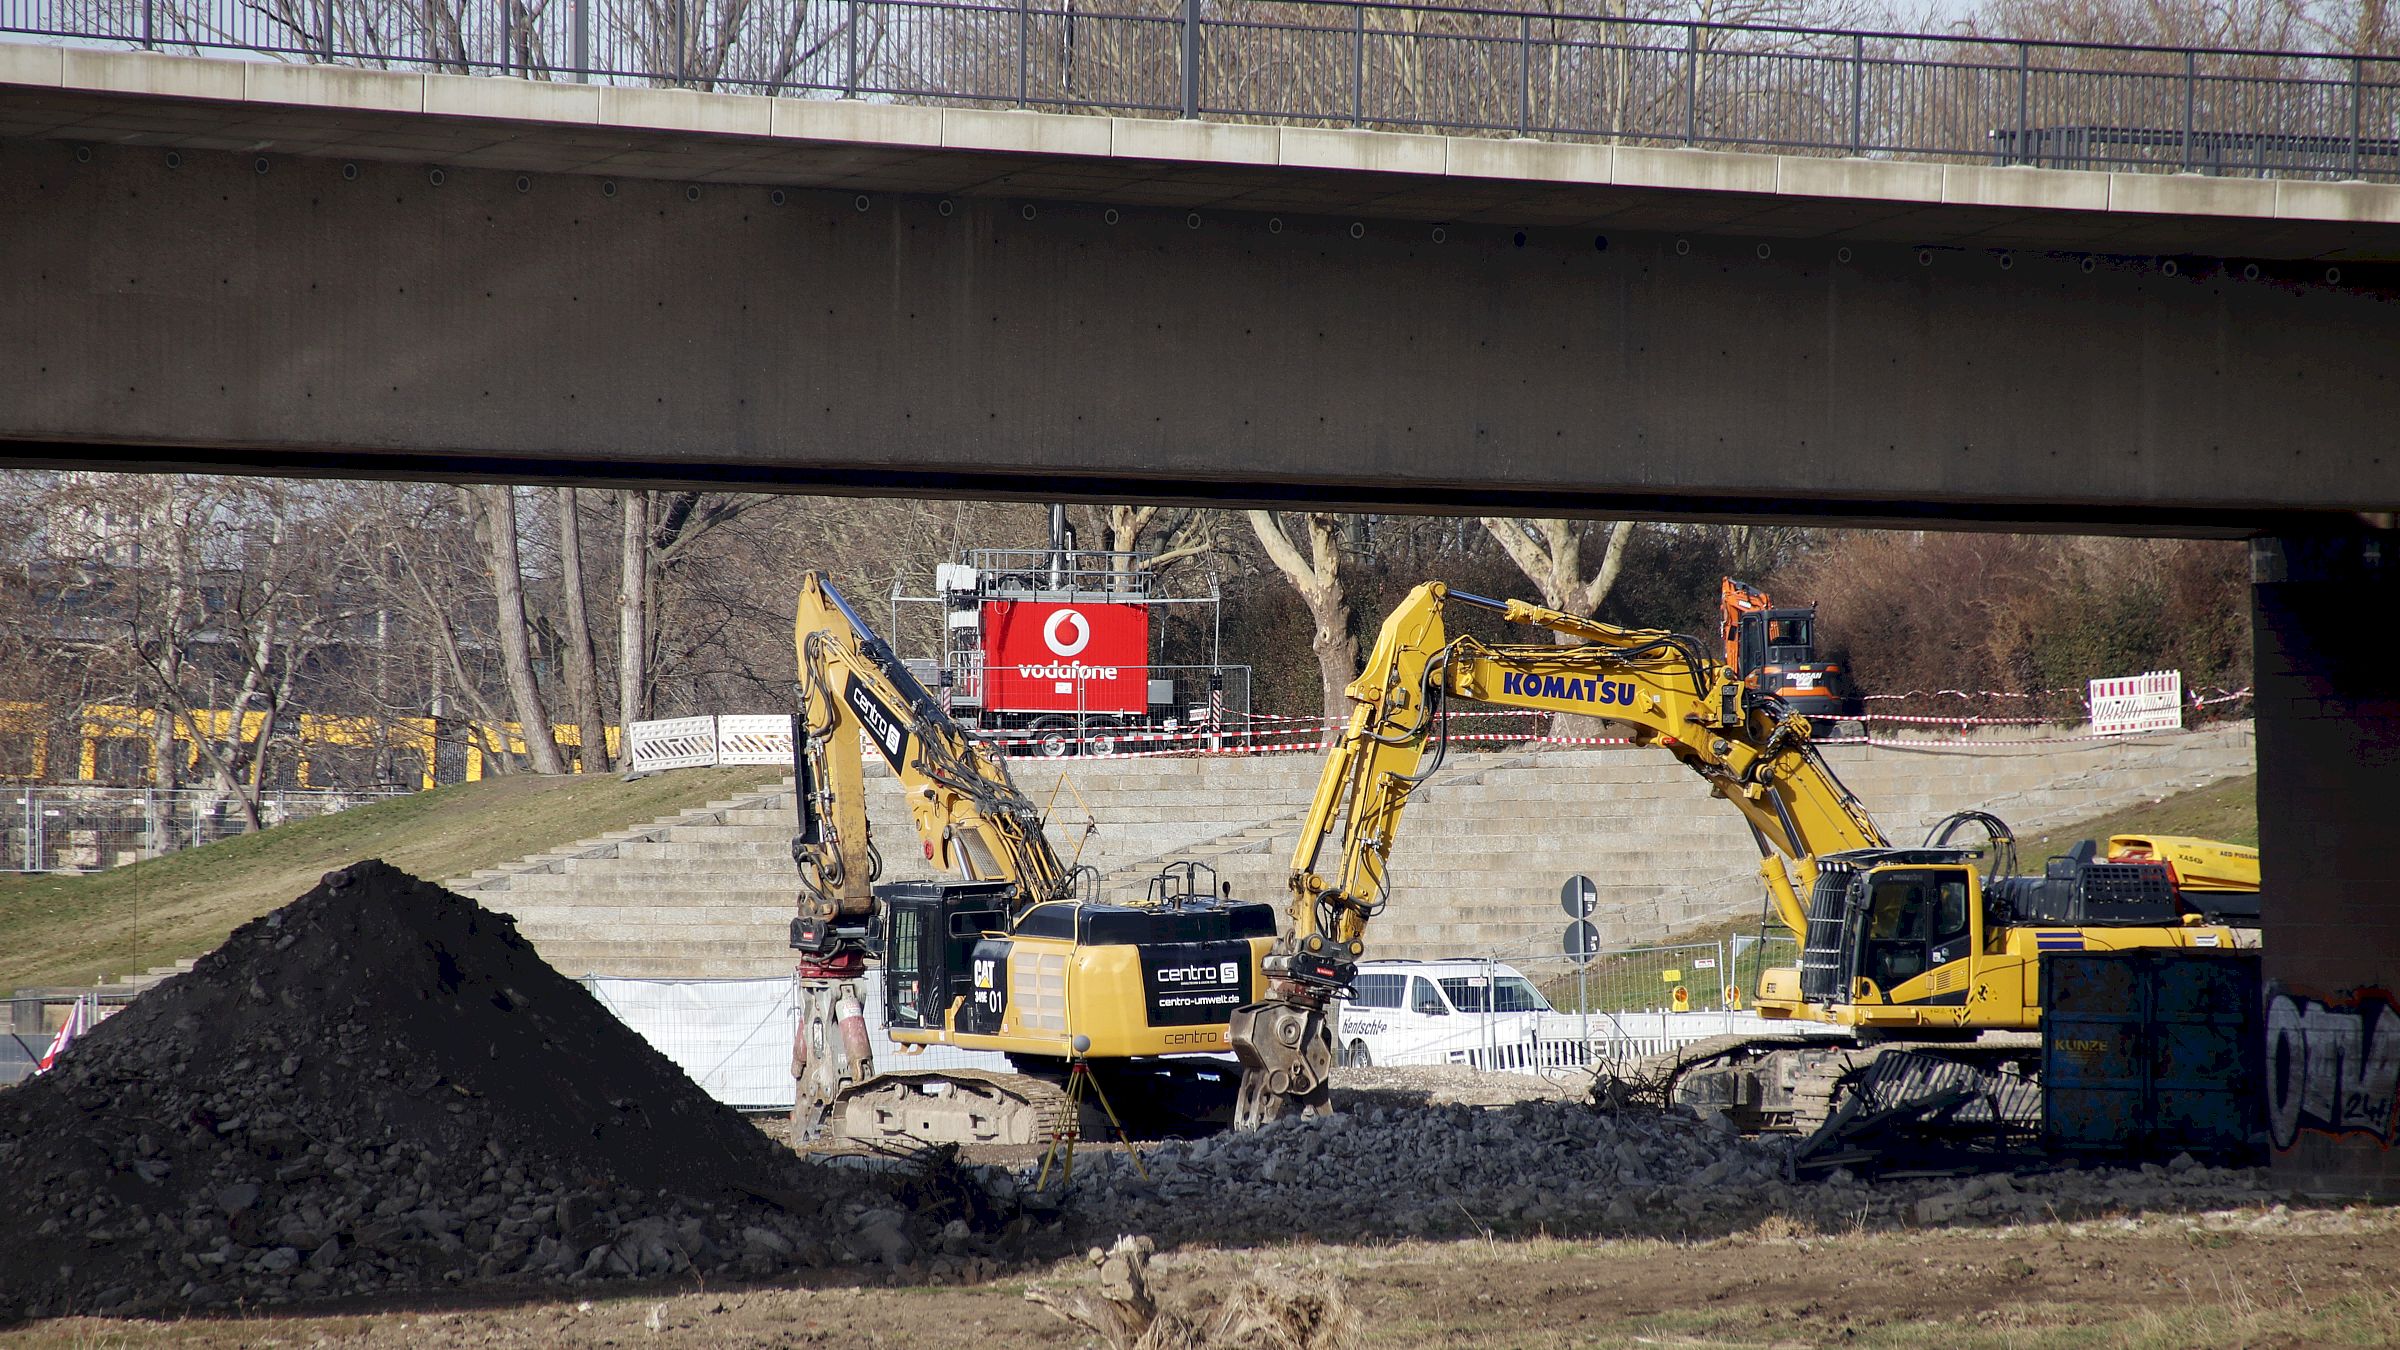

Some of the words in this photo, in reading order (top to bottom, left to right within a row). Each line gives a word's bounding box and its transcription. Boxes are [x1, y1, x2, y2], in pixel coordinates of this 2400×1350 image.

[1018, 660, 1118, 680] vodafone
[1786, 672, 1823, 680] DOOSAN
[1503, 671, 1636, 706] KOMATSU
[853, 687, 888, 736] centro
[974, 959, 995, 988] CAT
[1157, 964, 1217, 982] centro
[989, 990, 1003, 1014] 01
[1159, 994, 1240, 1007] centro-umwelt.de
[1164, 1030, 1218, 1045] centro
[2054, 1039, 2109, 1052] KUNZE
